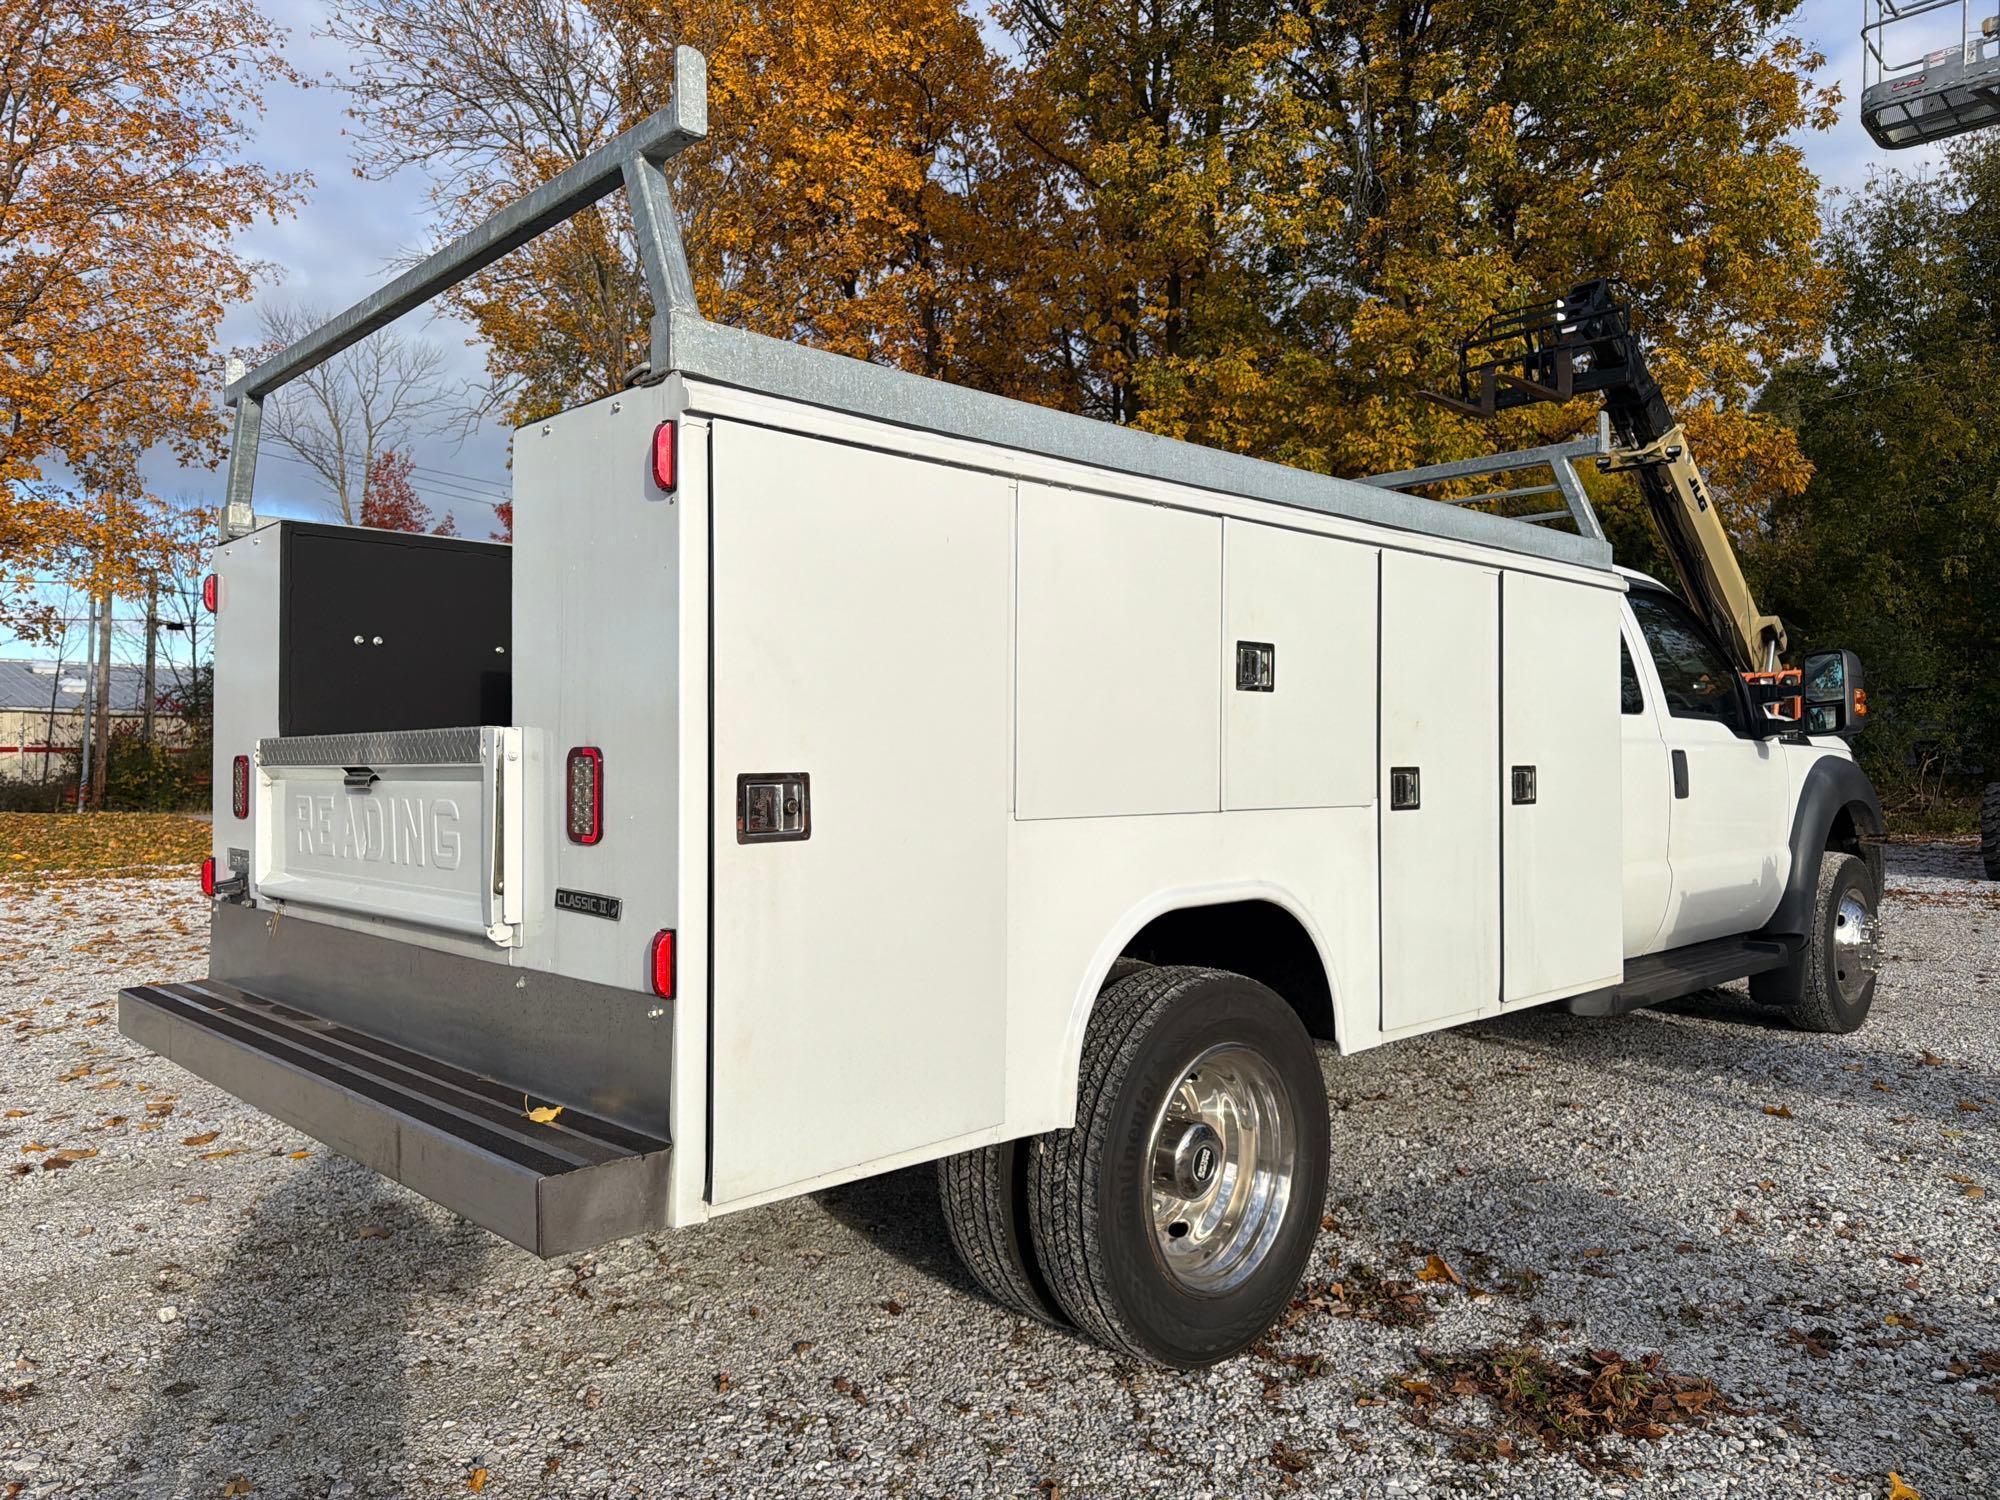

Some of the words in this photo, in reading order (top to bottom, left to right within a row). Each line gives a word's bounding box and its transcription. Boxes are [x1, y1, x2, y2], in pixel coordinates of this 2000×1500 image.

[1688, 478, 1708, 512] JLG
[296, 794, 462, 871] READING
[557, 892, 597, 912] CLASSIC
[600, 900, 608, 914] II
